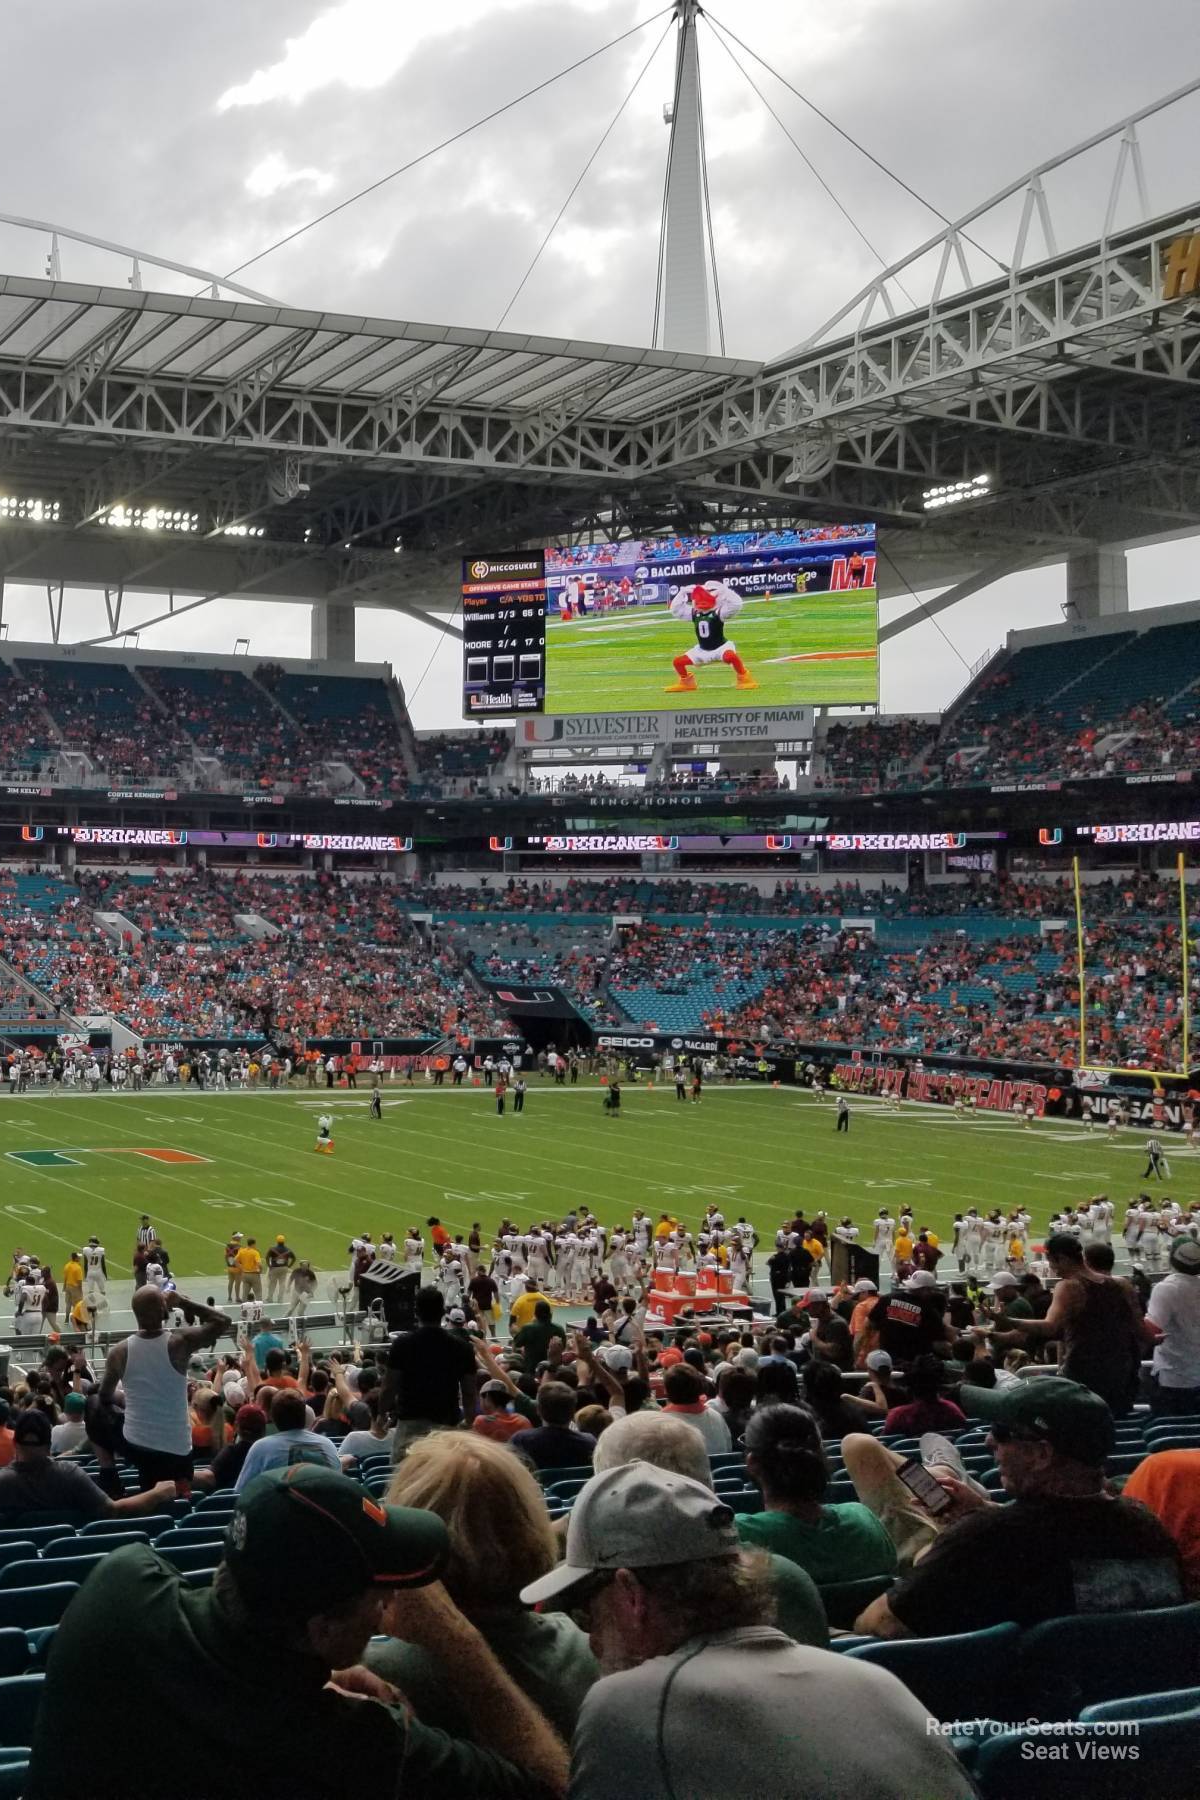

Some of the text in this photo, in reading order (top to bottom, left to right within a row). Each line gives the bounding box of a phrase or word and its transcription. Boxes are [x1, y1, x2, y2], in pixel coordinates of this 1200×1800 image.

[651, 561, 695, 577] BACARDÍ
[464, 598, 488, 607] Player
[464, 640, 492, 649] MOORE
[674, 710, 805, 726] UNIVERSITY OF MIAMI
[566, 716, 659, 735] SYLVESTER
[674, 725, 769, 739] HEALTH SYSTEM
[597, 1036, 655, 1048] GEICO
